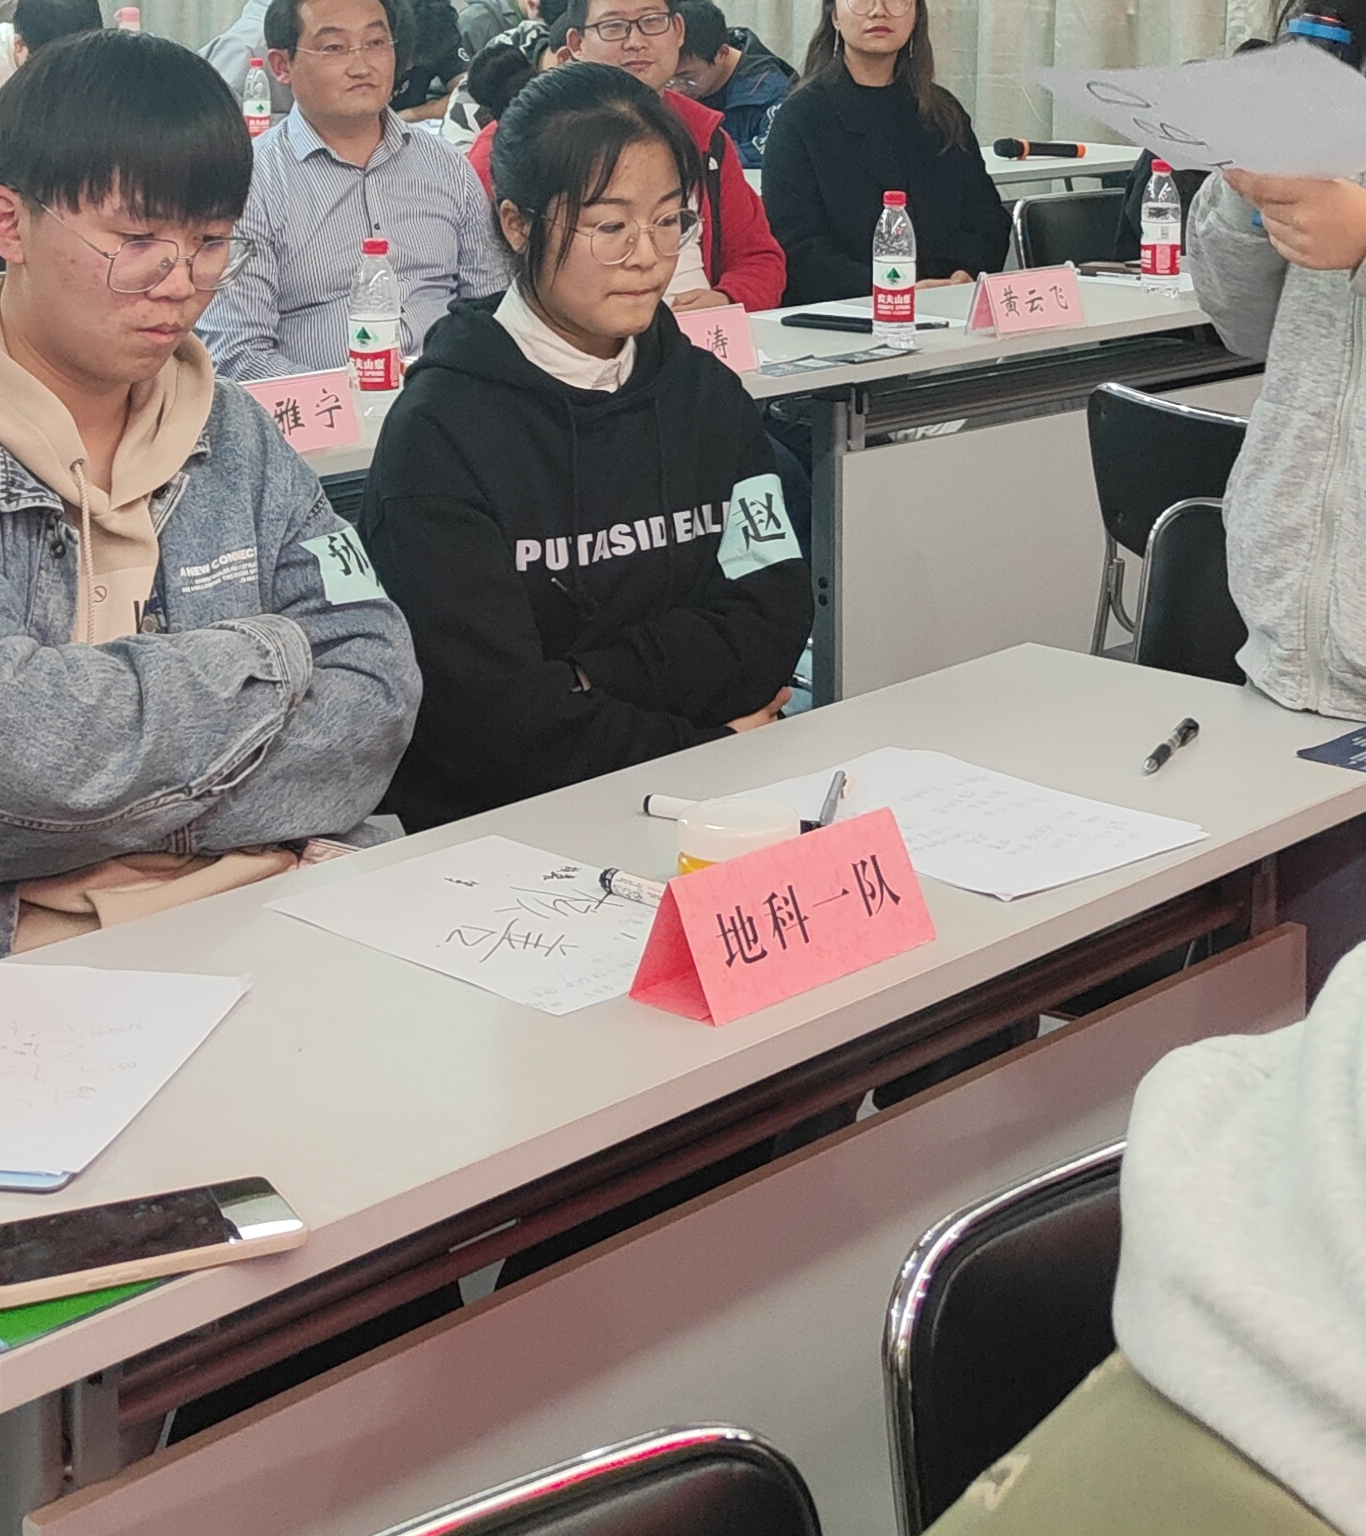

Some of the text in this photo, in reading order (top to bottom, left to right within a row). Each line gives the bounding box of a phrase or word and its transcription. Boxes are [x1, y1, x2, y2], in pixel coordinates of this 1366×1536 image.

[999, 284, 1070, 318] 黄云飞
[715, 854, 902, 968] 地科一队
